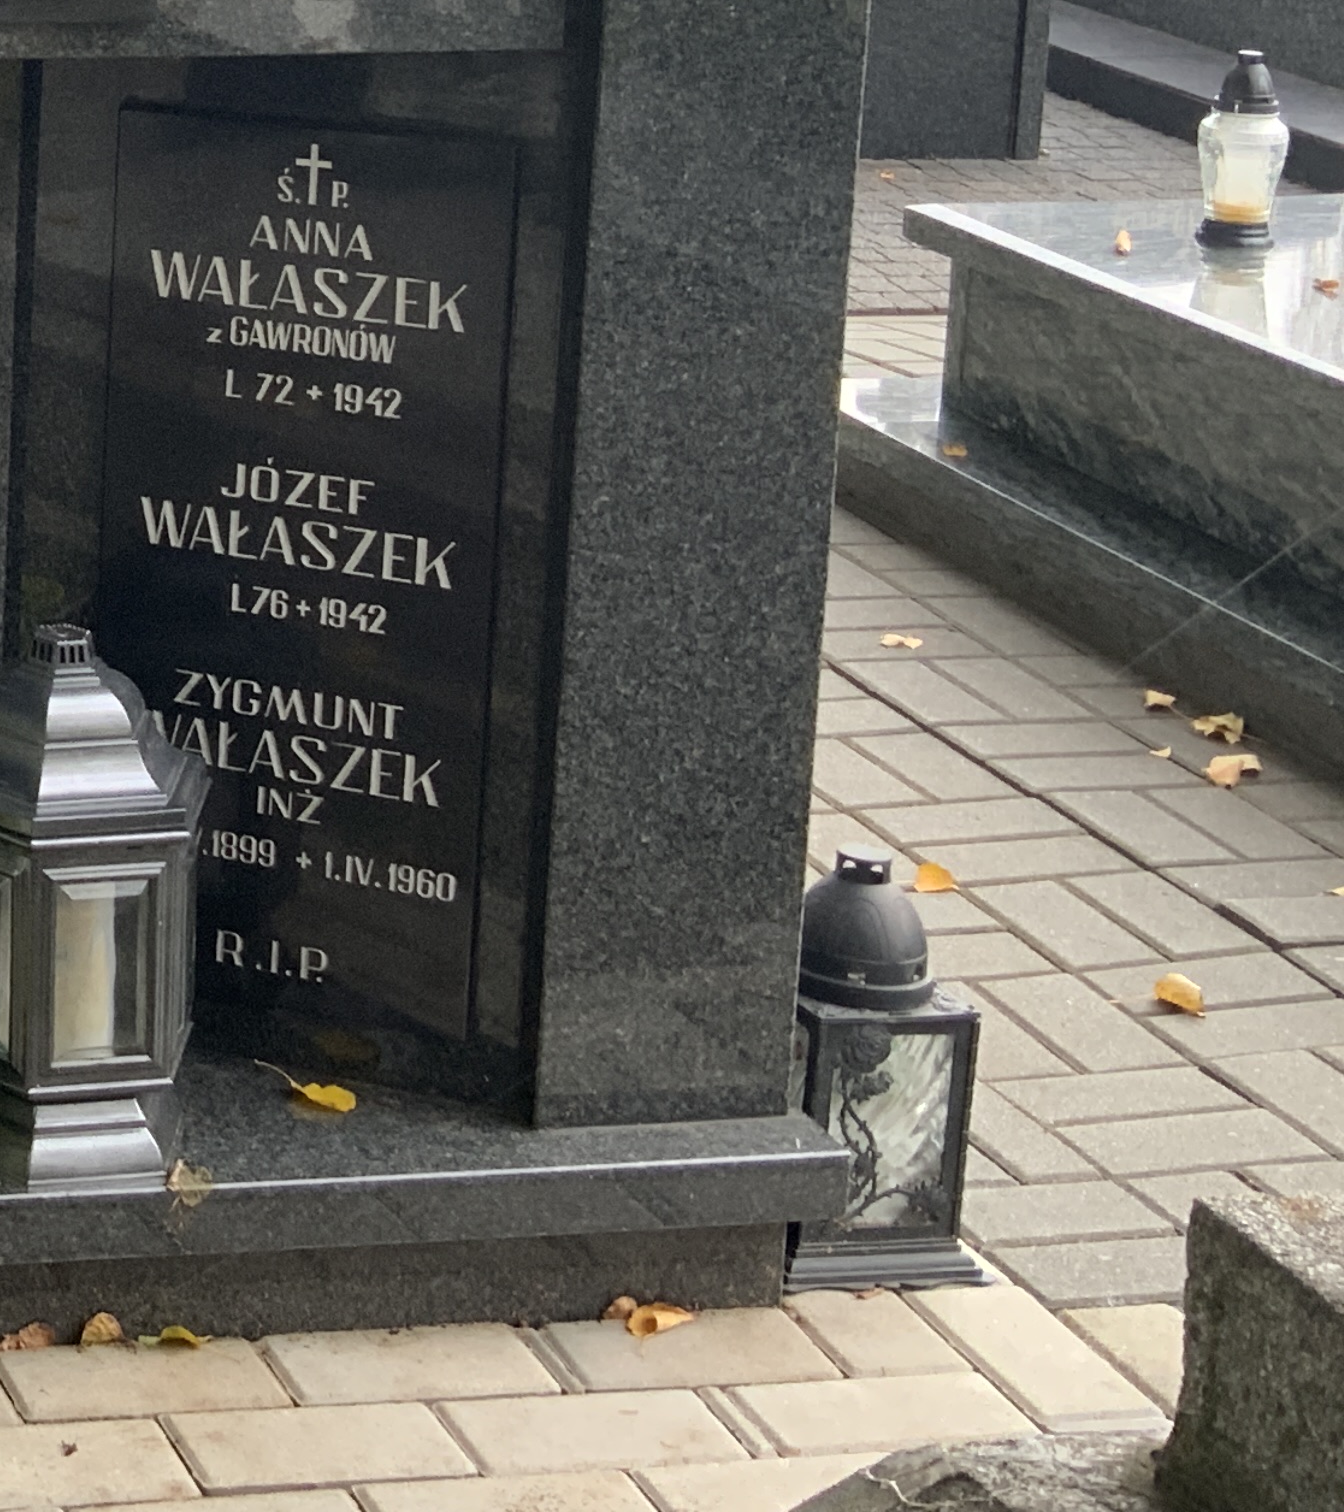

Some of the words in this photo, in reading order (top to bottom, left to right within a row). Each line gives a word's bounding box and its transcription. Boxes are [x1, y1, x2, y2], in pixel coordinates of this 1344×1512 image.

[249, 214, 373, 261] ANNA
[150, 249, 468, 334] WAŁASZEK
[229, 316, 396, 365] GAWRONÓW
[333, 383, 403, 420] 1942
[221, 457, 376, 515] JÓZEF
[140, 496, 457, 589] WAŁASZEK
[319, 596, 387, 635] 1942
[173, 667, 405, 740] ZYGMUNT
[257, 786, 324, 825] INŻ
